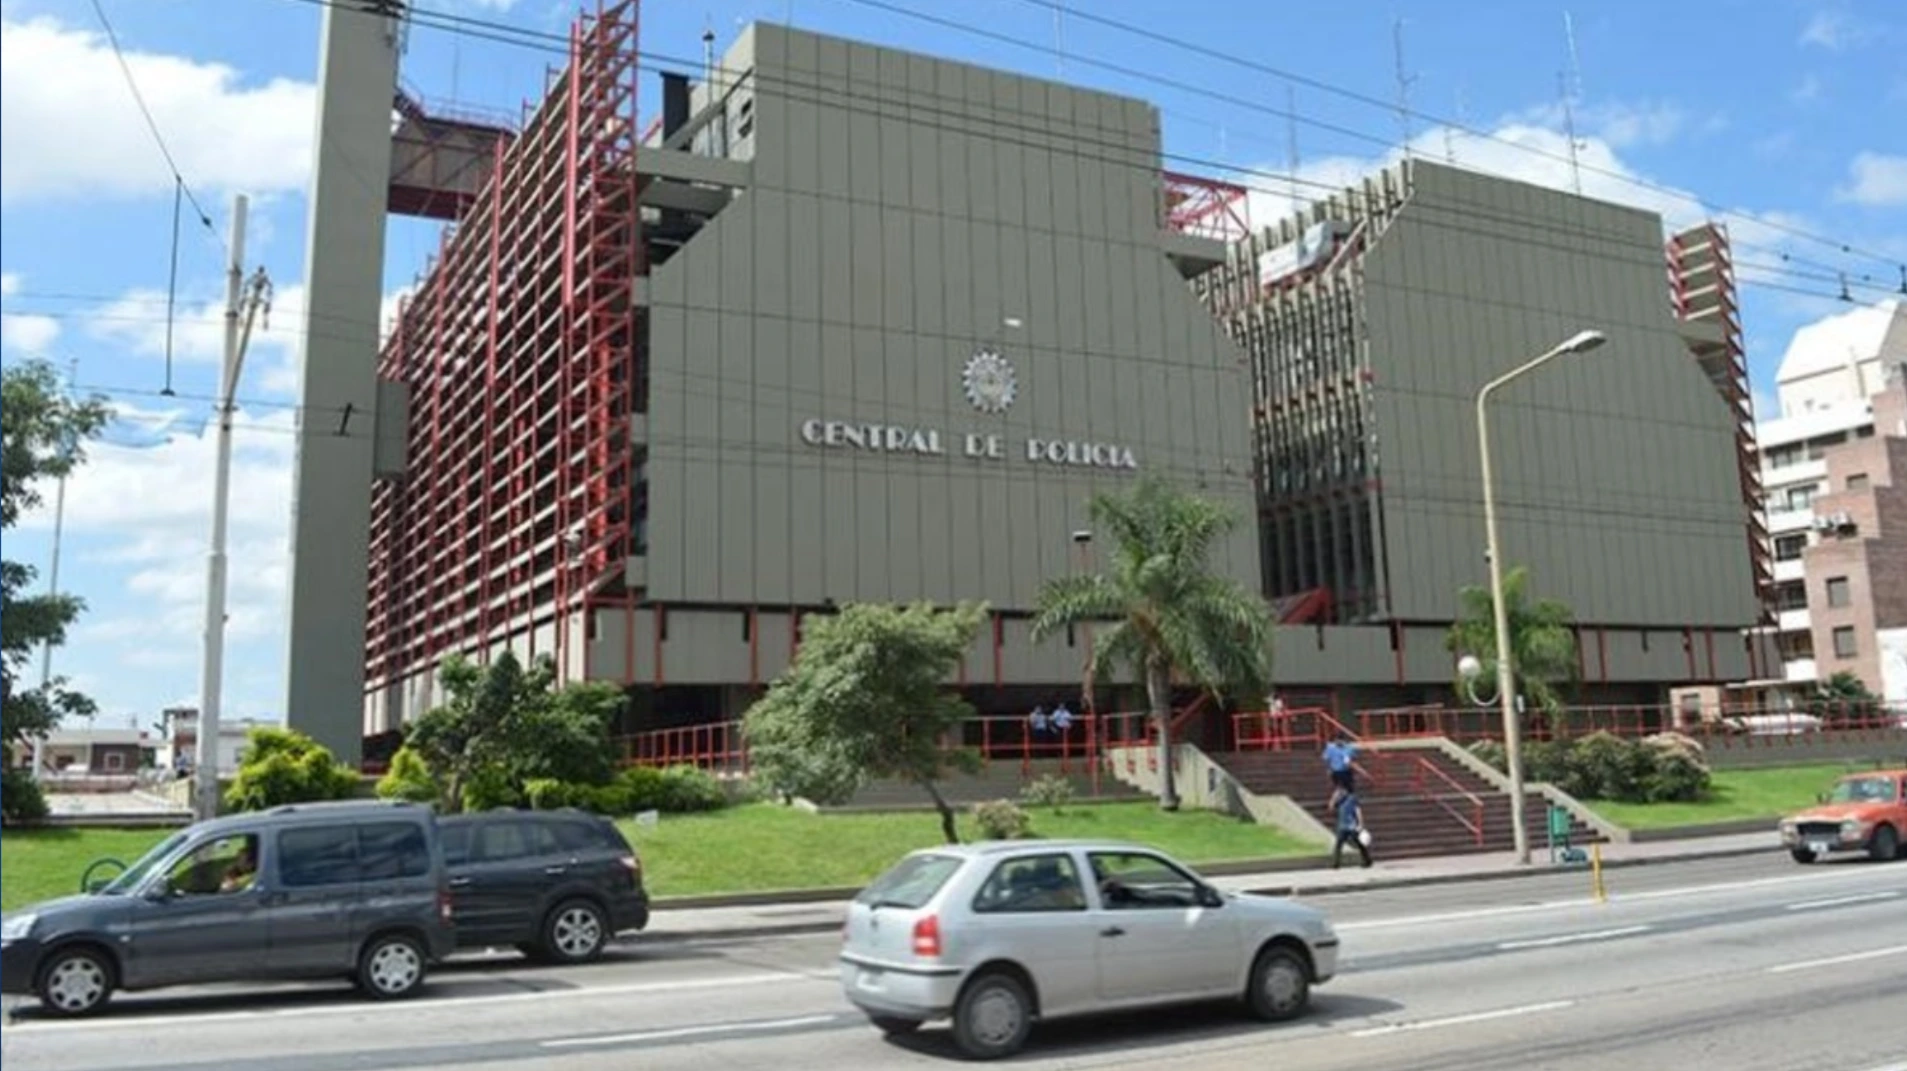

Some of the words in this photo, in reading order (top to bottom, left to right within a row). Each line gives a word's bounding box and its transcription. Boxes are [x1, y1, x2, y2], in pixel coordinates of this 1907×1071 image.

[802, 418, 944, 455] CENTRAL
[965, 433, 1004, 459] DE
[1027, 438, 1137, 469] POLICIA
